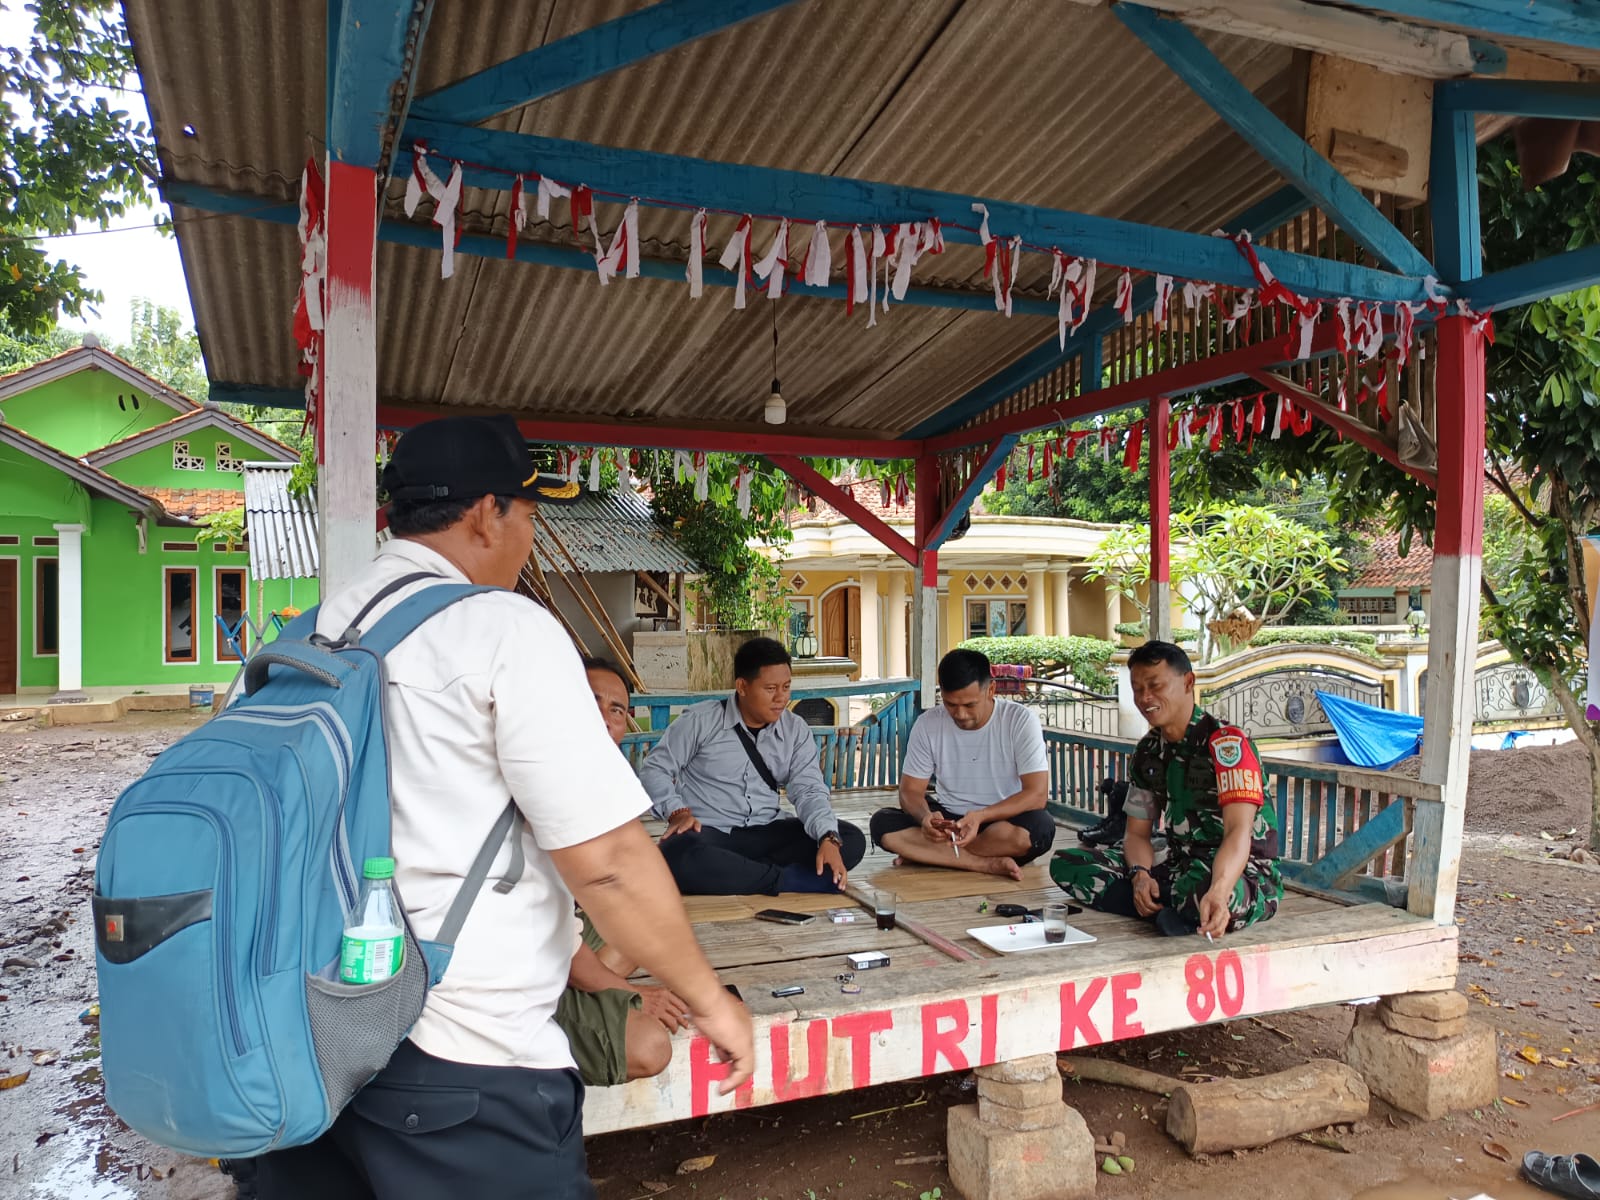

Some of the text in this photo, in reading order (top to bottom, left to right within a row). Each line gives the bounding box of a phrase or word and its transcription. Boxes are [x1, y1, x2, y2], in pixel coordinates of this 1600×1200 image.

[689, 948, 1245, 1118] HUT RI KE 80
